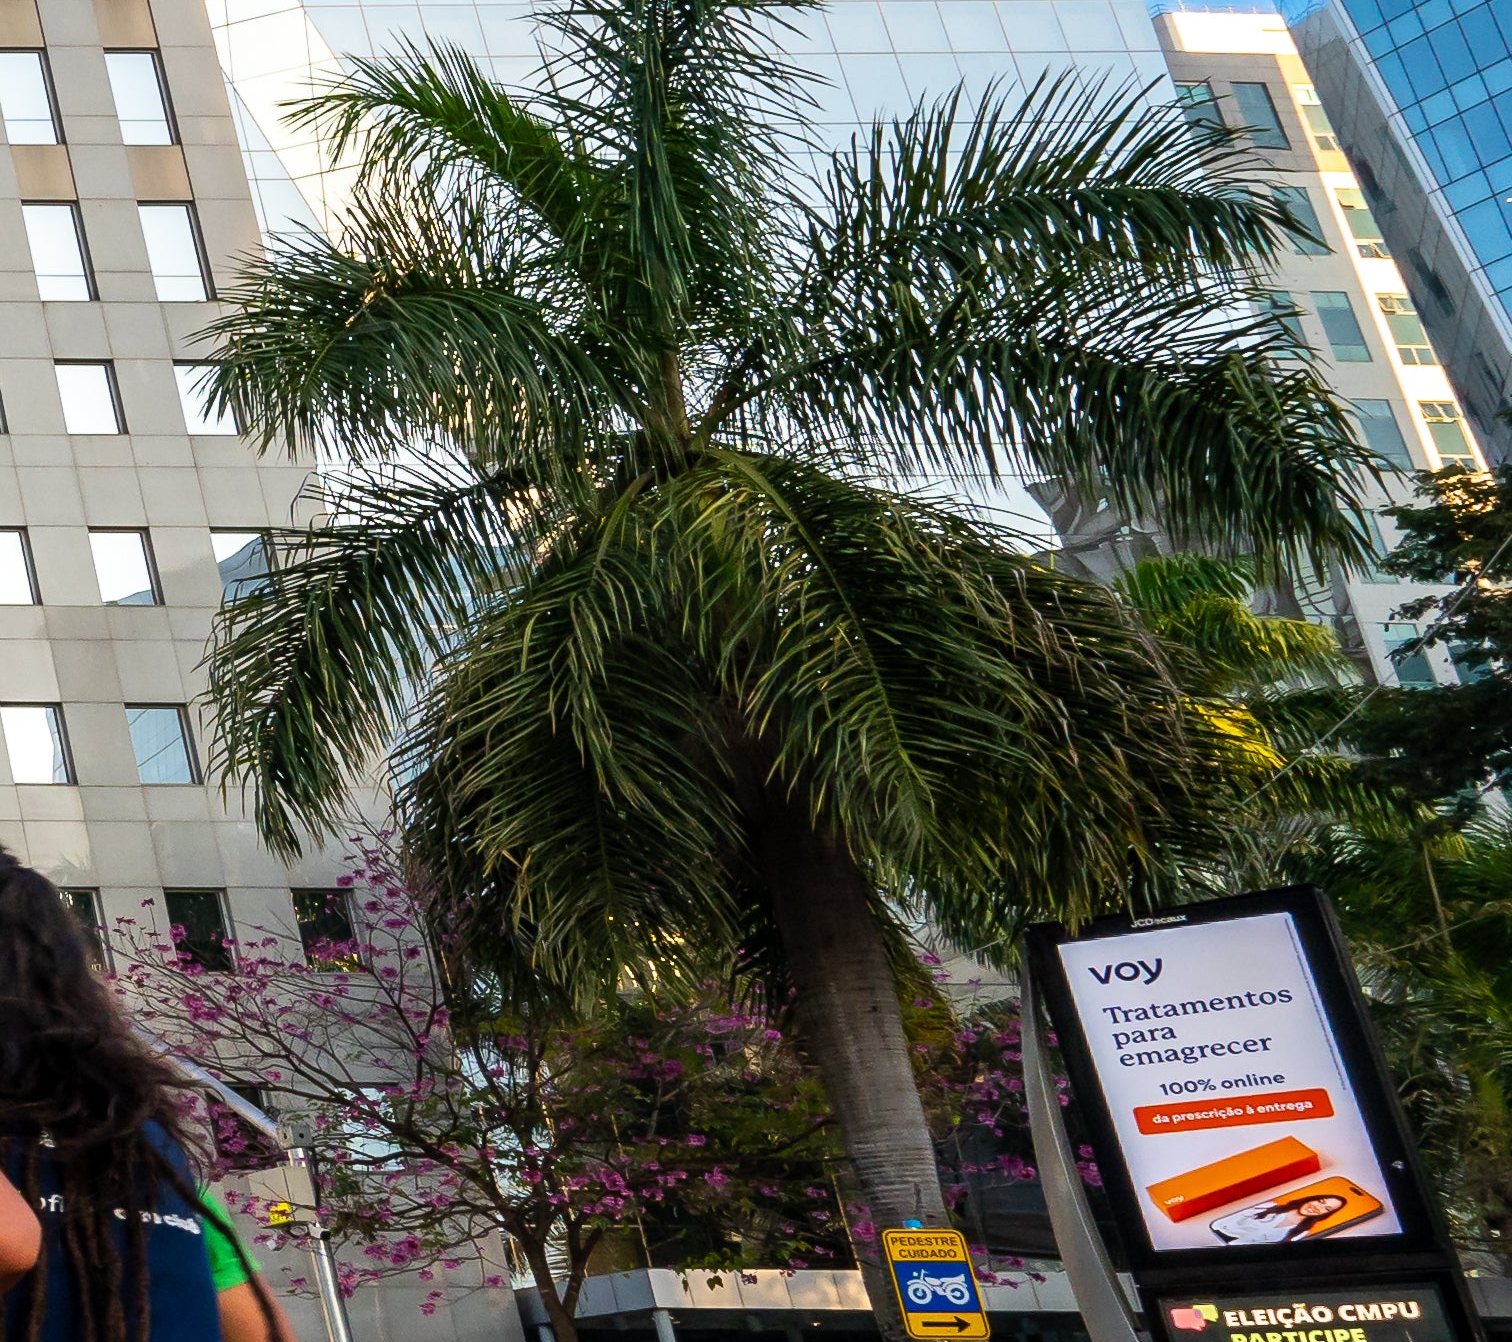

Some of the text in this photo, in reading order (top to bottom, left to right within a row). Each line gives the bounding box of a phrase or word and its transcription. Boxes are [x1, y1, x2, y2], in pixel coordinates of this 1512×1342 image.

[1088, 958, 1163, 985] voy
[1102, 988, 1293, 1025] Tratamentos
[1111, 1026, 1177, 1050] para
[1119, 1035, 1273, 1067] emagrecer
[1160, 1072, 1286, 1096] 100% online
[1152, 1114, 1170, 1125] da
[1171, 1105, 1244, 1125] prescrição
[1257, 1100, 1313, 1115] entrega
[890, 1236, 958, 1247] PEDESTRE
[898, 1249, 957, 1259] CUIDADO
[1223, 1300, 1421, 1329] ELEIÇÃO CMPU
